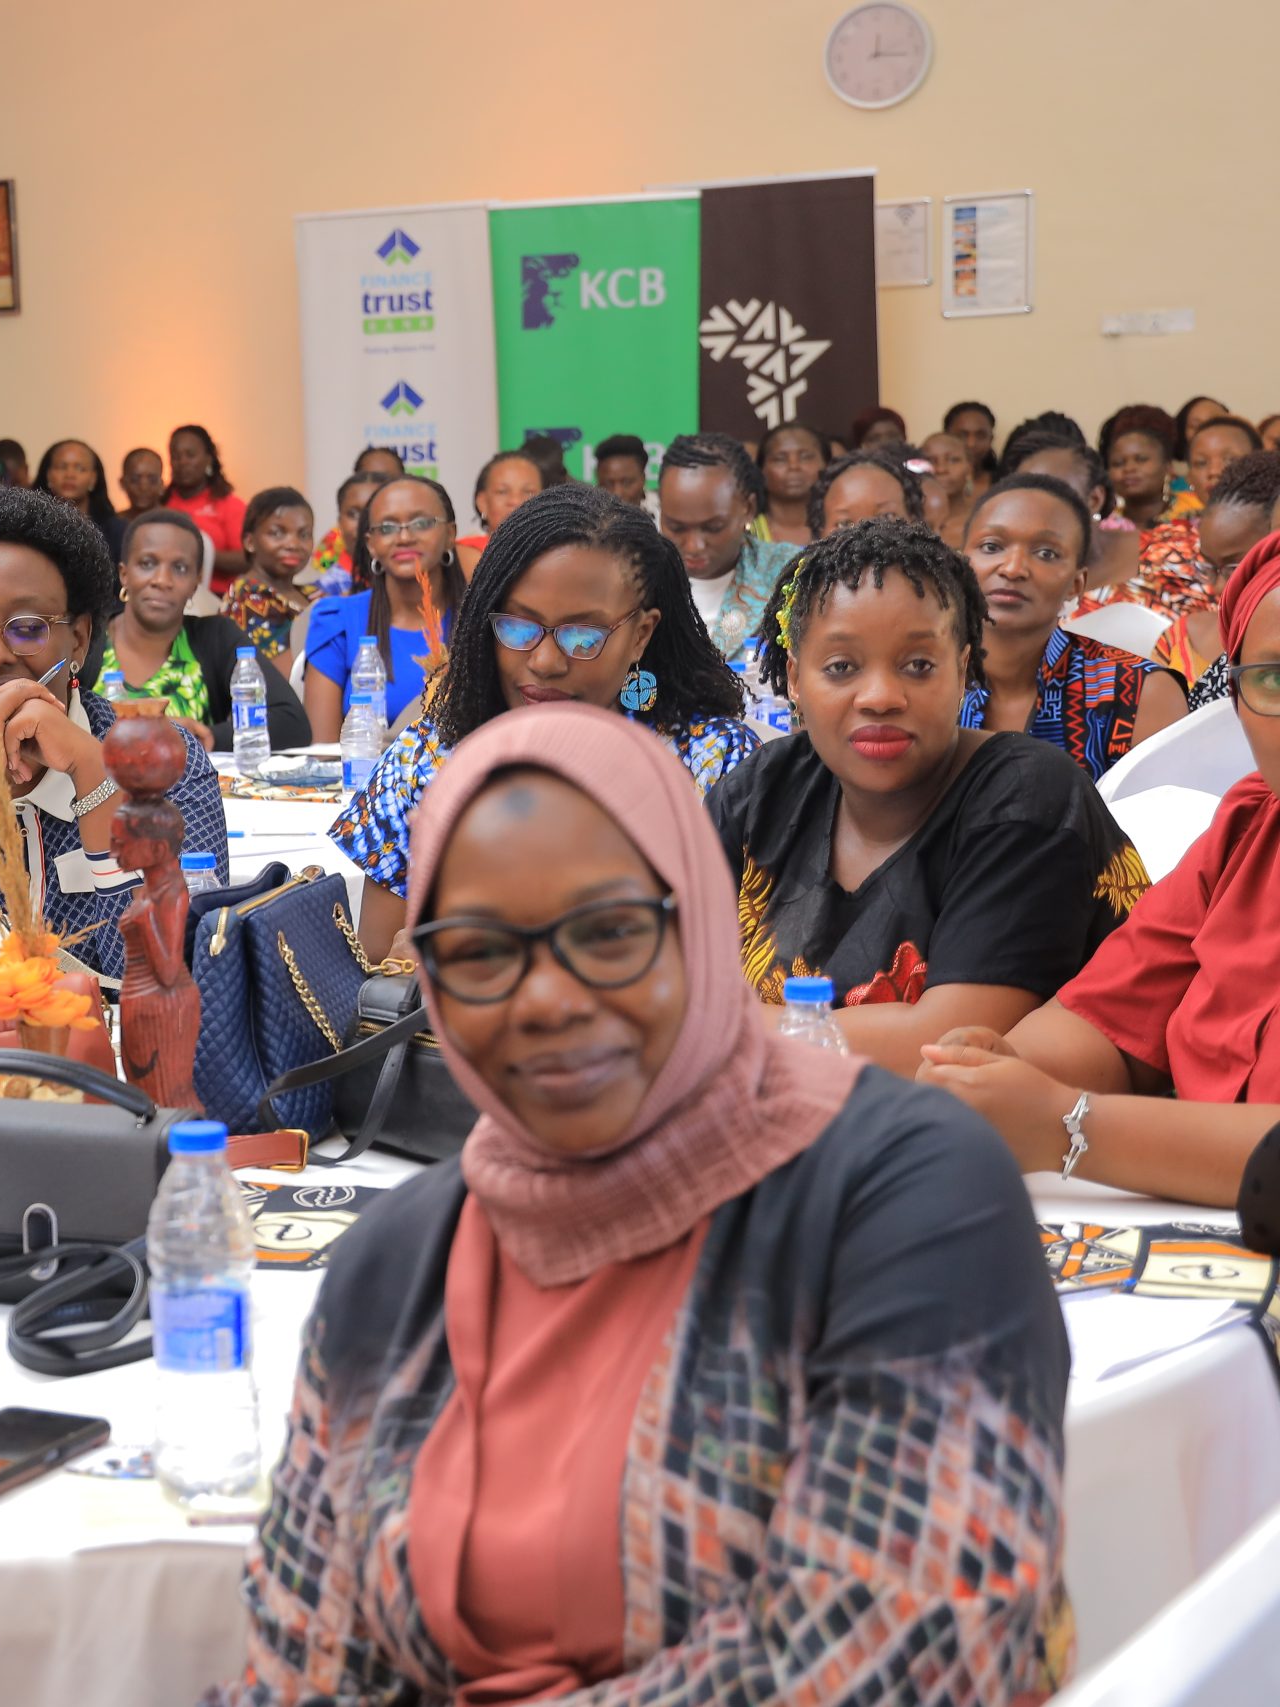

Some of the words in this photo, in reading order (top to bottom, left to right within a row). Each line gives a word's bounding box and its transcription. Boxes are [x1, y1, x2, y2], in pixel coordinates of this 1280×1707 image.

[360, 272, 432, 288] FINANCE
[579, 267, 666, 310] KCB
[363, 288, 433, 314] trust
